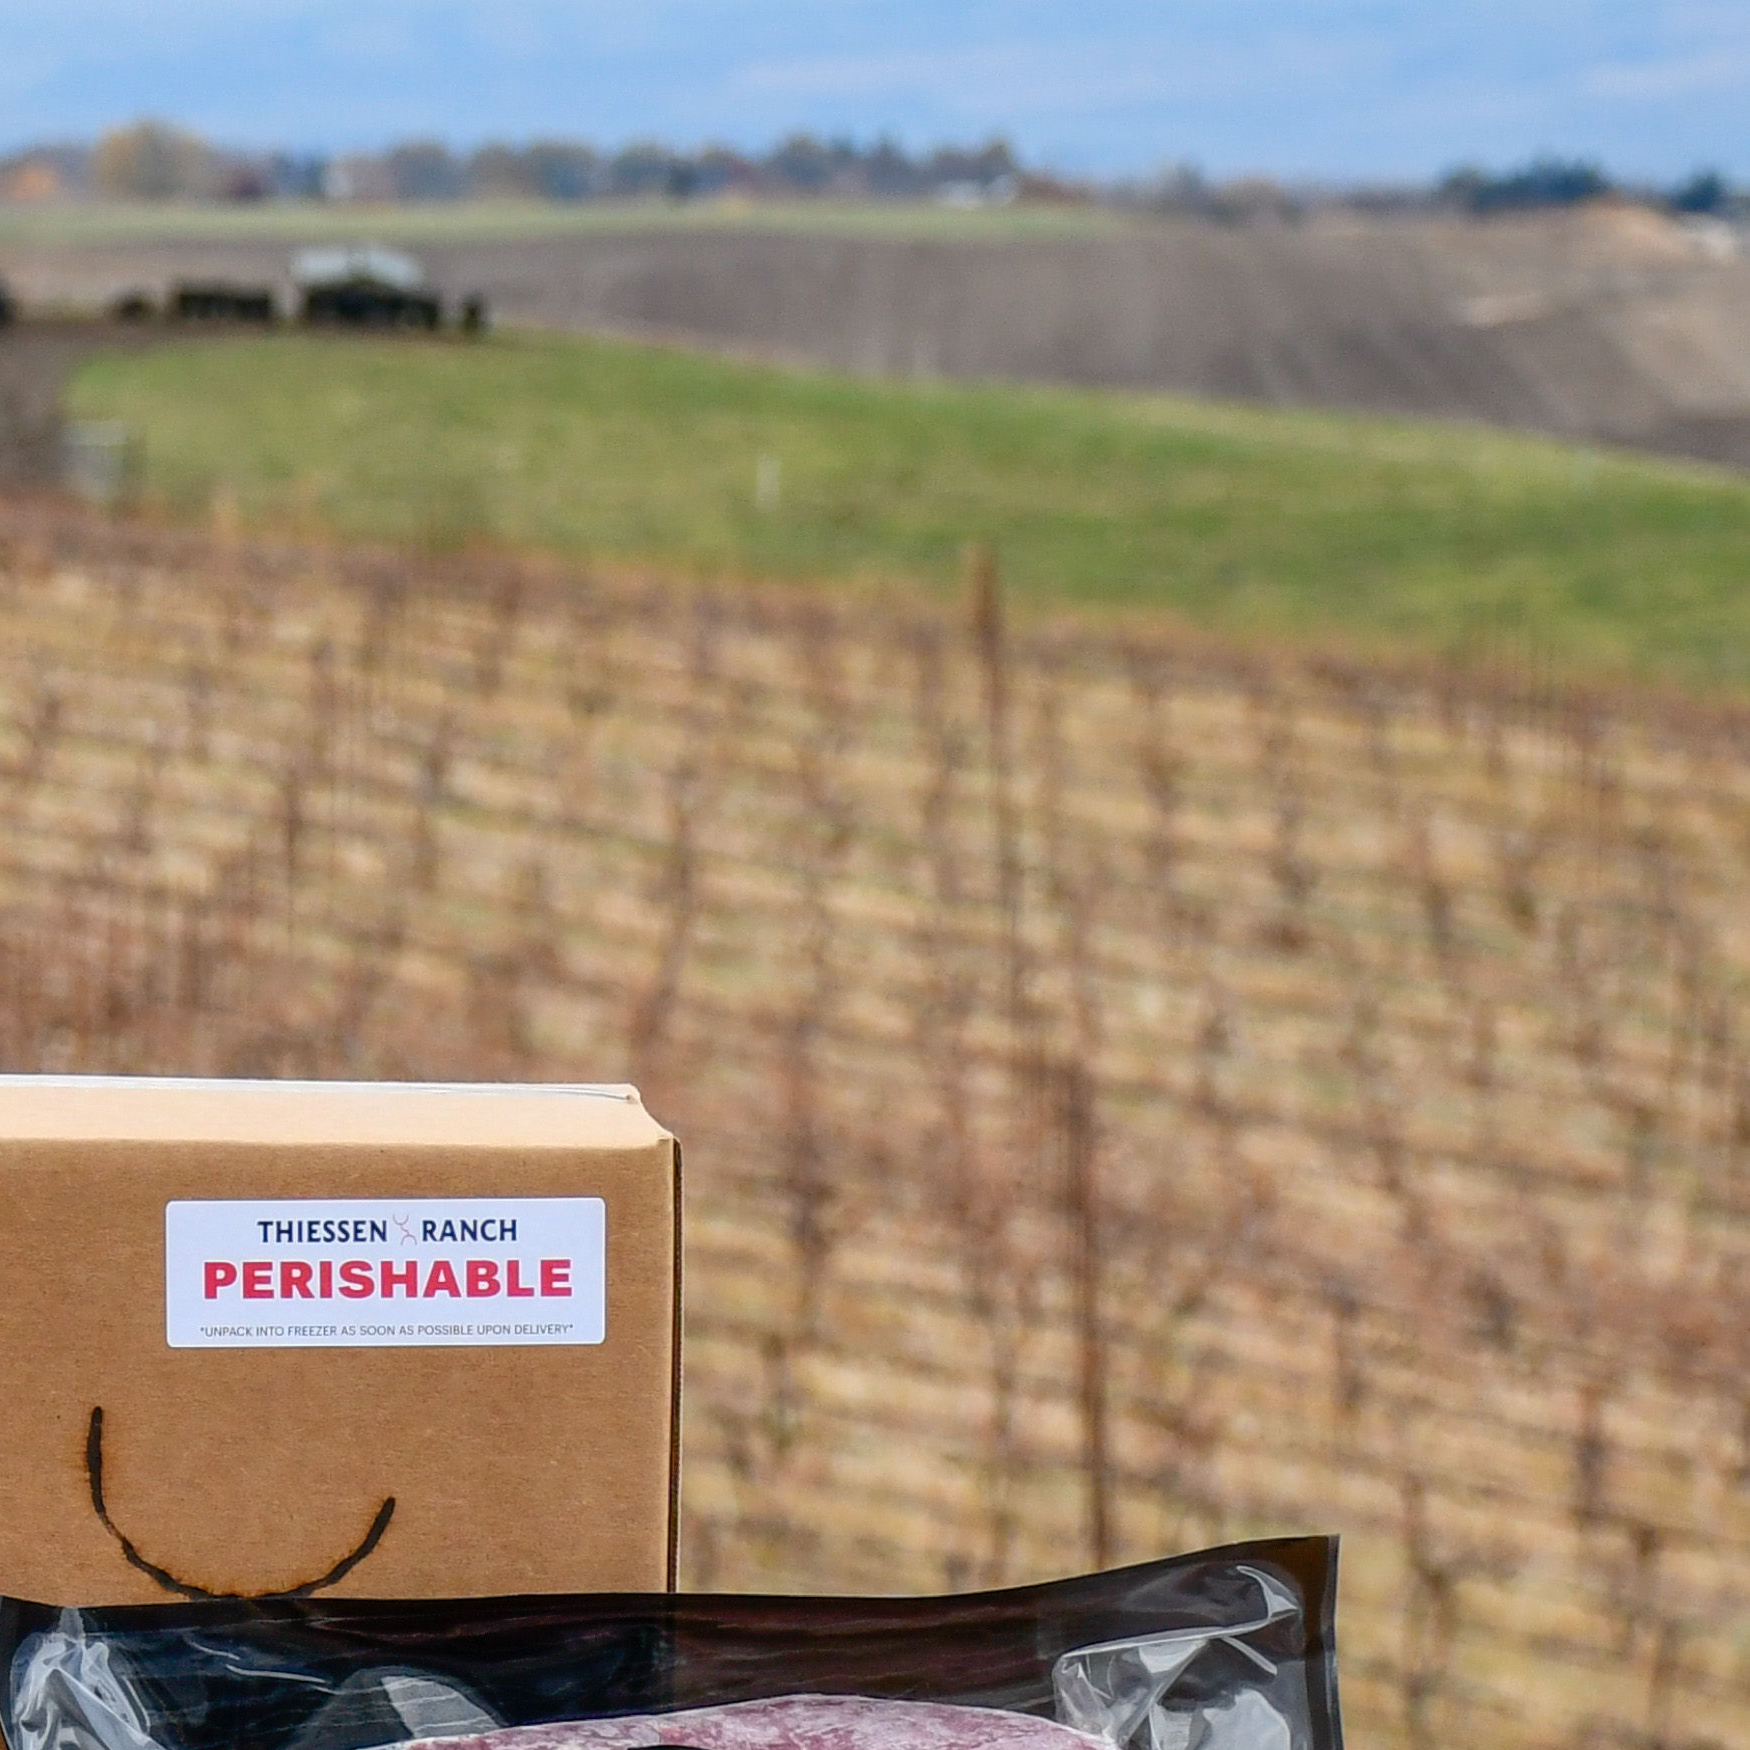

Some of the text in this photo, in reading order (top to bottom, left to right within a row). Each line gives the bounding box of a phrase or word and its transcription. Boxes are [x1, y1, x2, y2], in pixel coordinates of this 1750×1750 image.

[257, 1219, 517, 1243] THIESSEN RANCH
[204, 1260, 572, 1299] PERISHABLE
[256, 1326, 284, 1337] INTO
[288, 1325, 337, 1337] FREEZER
[340, 1325, 356, 1336] AS
[359, 1325, 395, 1336] SOON
[398, 1325, 414, 1336] AS
[417, 1325, 473, 1336] POSSIBLE
[477, 1324, 511, 1336] UPON
